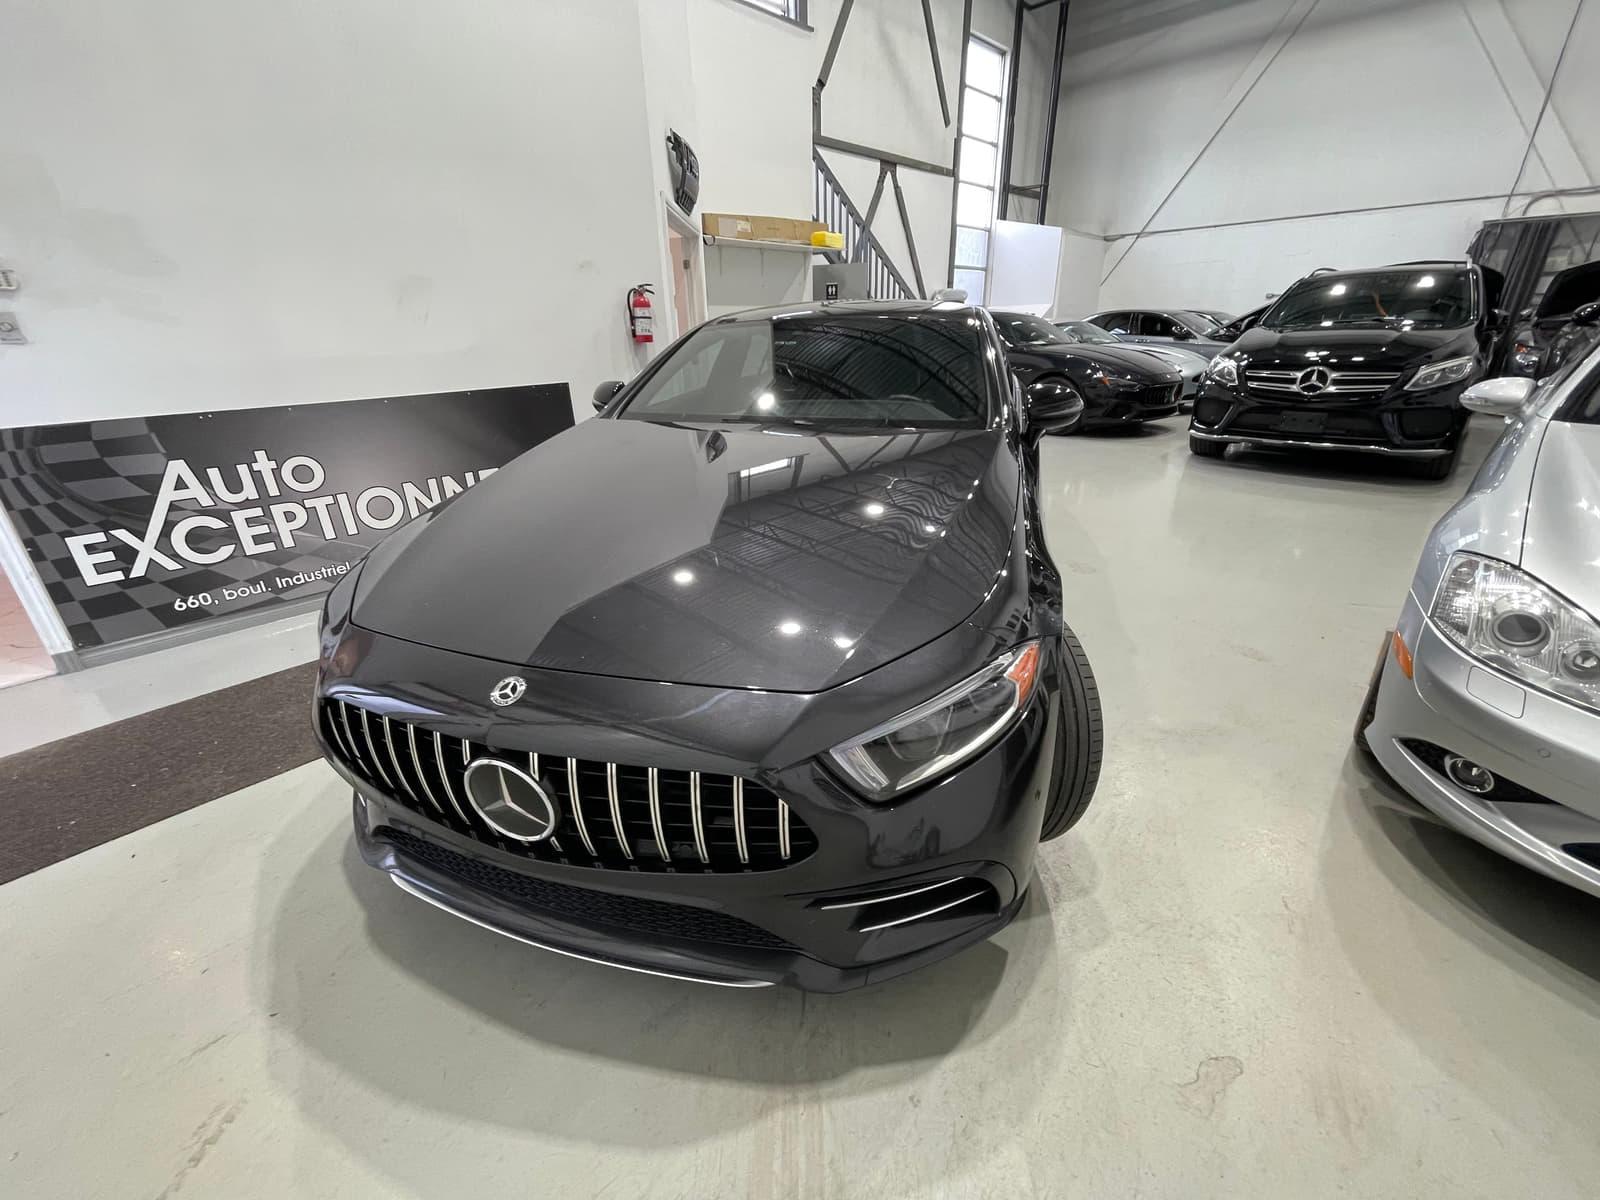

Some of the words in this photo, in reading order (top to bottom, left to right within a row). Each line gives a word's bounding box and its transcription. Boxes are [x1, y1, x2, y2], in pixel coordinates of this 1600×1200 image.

[154, 449, 326, 508] Auto
[64, 467, 500, 587] EXCEPTIONN
[173, 592, 220, 612] 660,
[222, 580, 273, 601] boul.
[275, 561, 351, 589] Industriel
